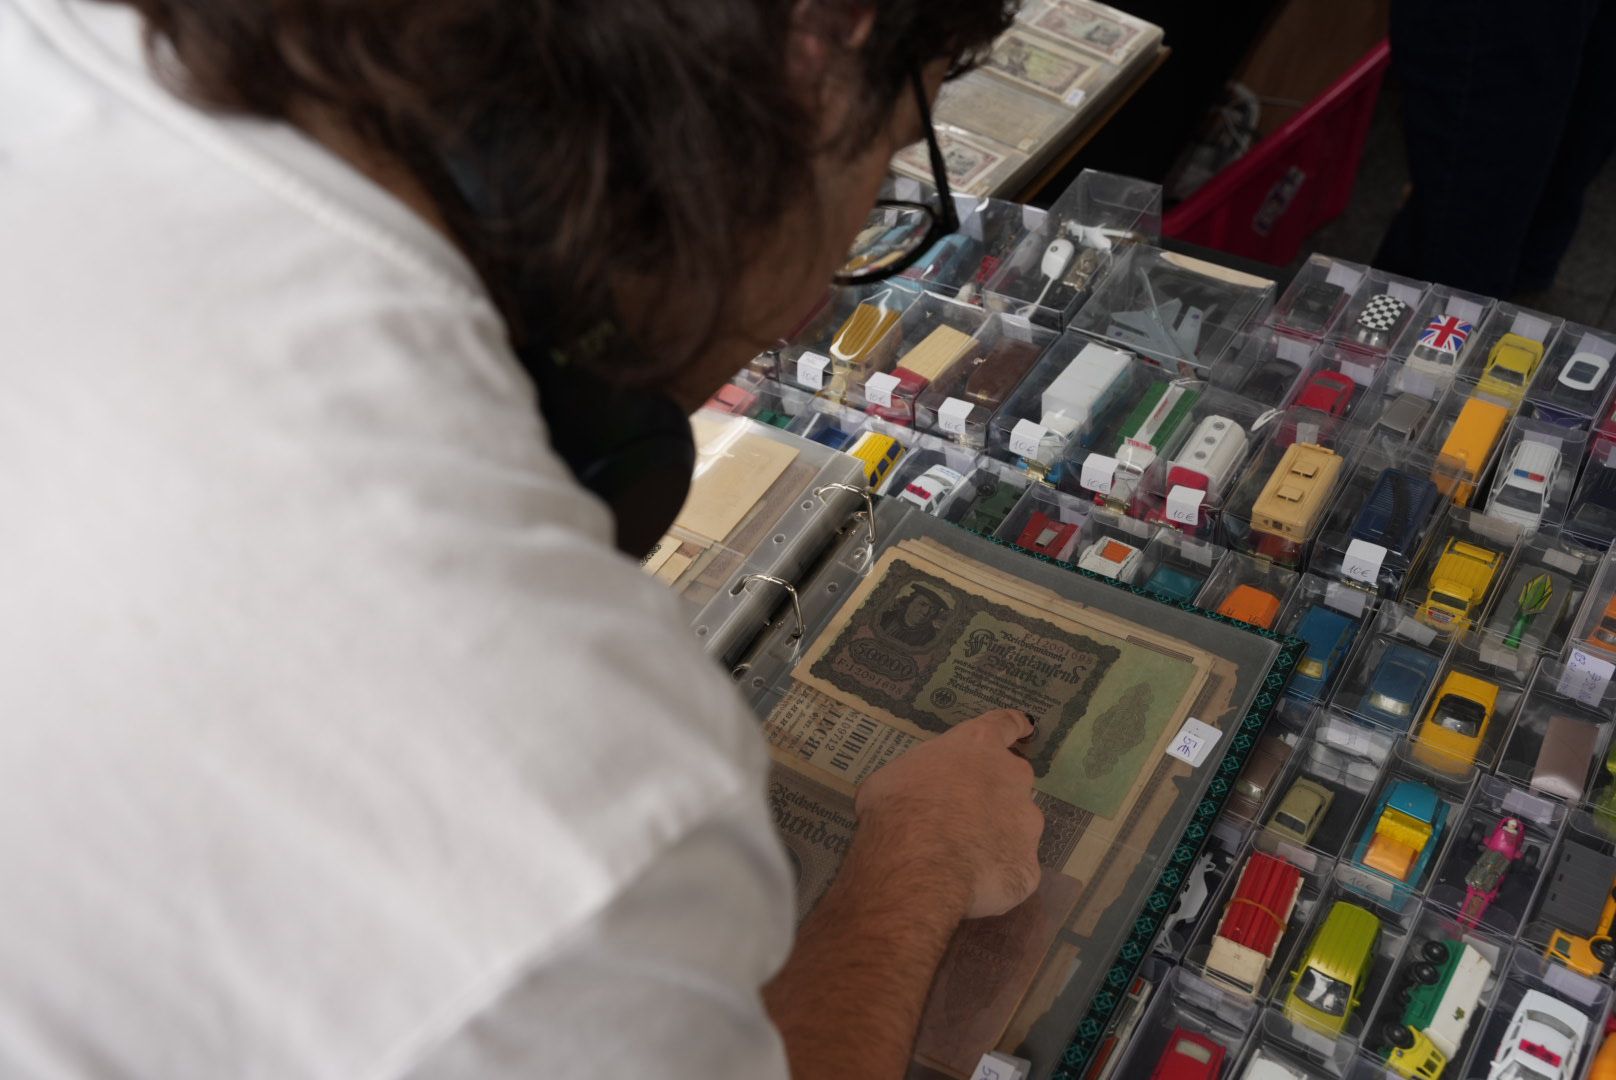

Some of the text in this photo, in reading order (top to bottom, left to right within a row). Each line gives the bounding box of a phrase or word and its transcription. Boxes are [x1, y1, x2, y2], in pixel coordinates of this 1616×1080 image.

[1173, 509, 1193, 521] 10€
[1346, 564, 1371, 577] 10€
[1175, 734, 1198, 758] 5€
